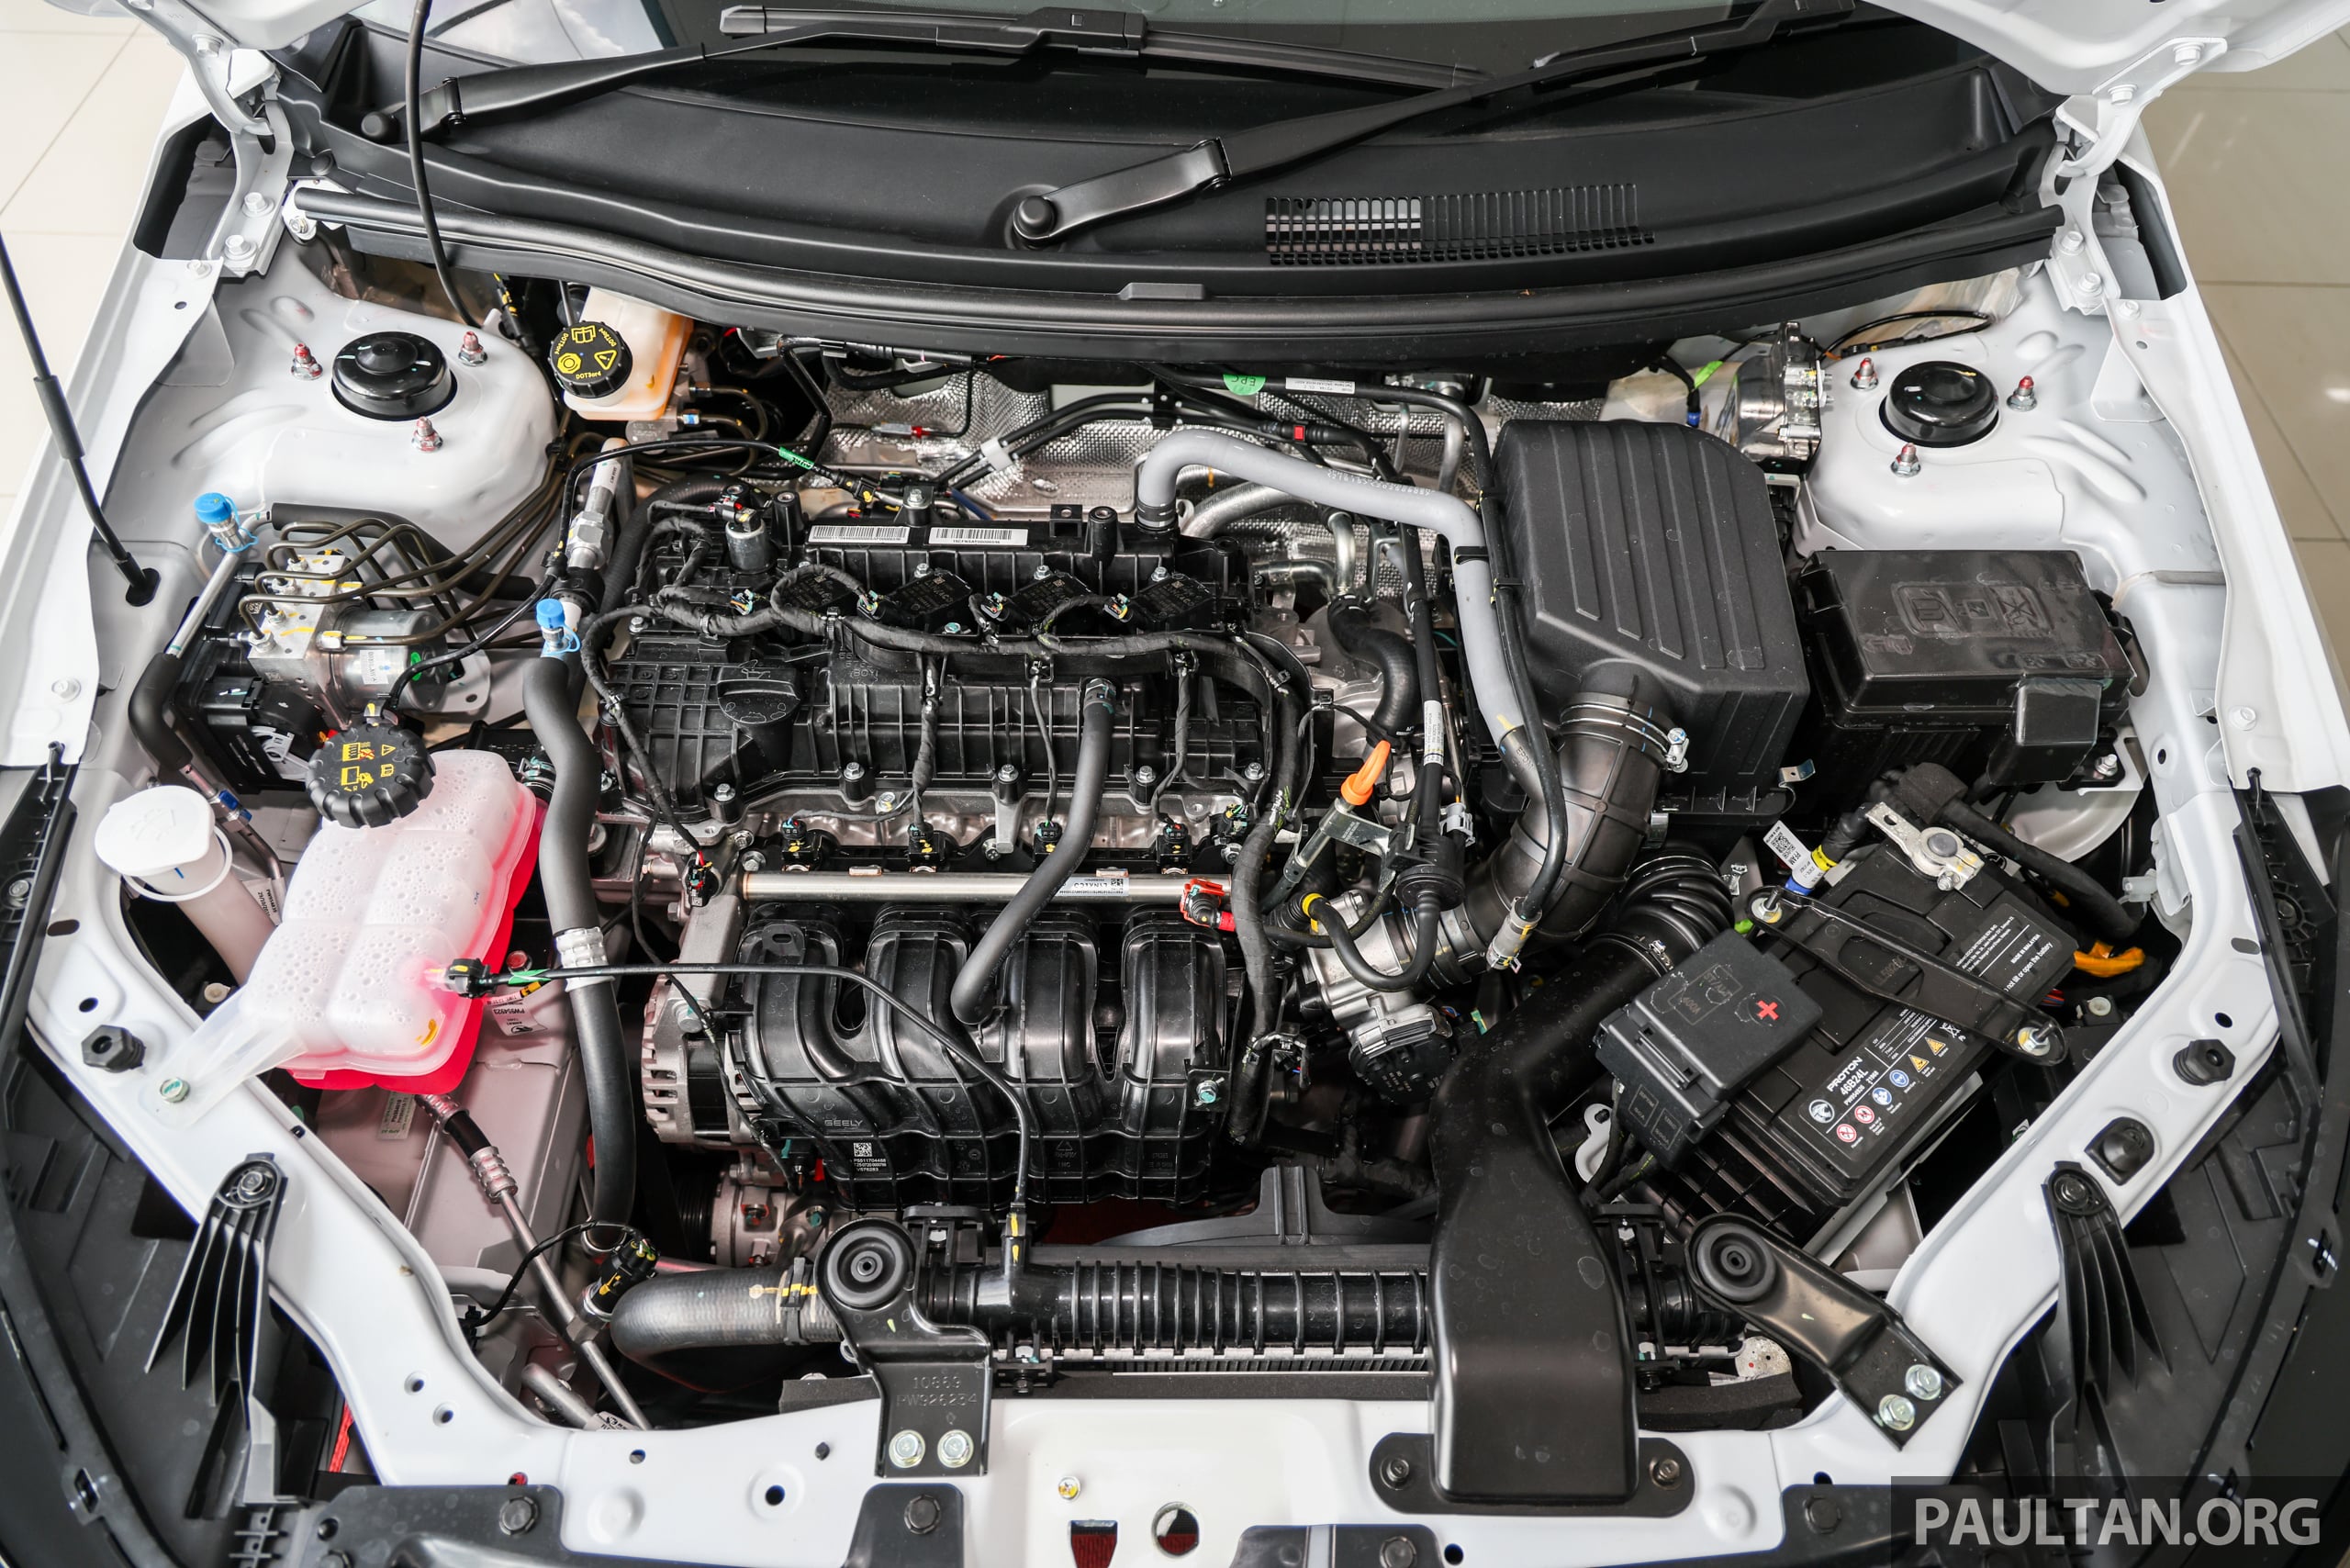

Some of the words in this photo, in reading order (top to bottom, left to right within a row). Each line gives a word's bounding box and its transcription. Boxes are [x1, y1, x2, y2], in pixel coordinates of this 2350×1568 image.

[576, 371, 600, 379] DOT3or4
[2009, 952, 2021, 964] MADE
[2022, 933, 2041, 950] MALAYSIA
[2021, 959, 2034, 974] open
[2036, 941, 2053, 958] battery
[1826, 1055, 1863, 1092] PROTON
[1838, 1066, 1868, 1096] 46B24L
